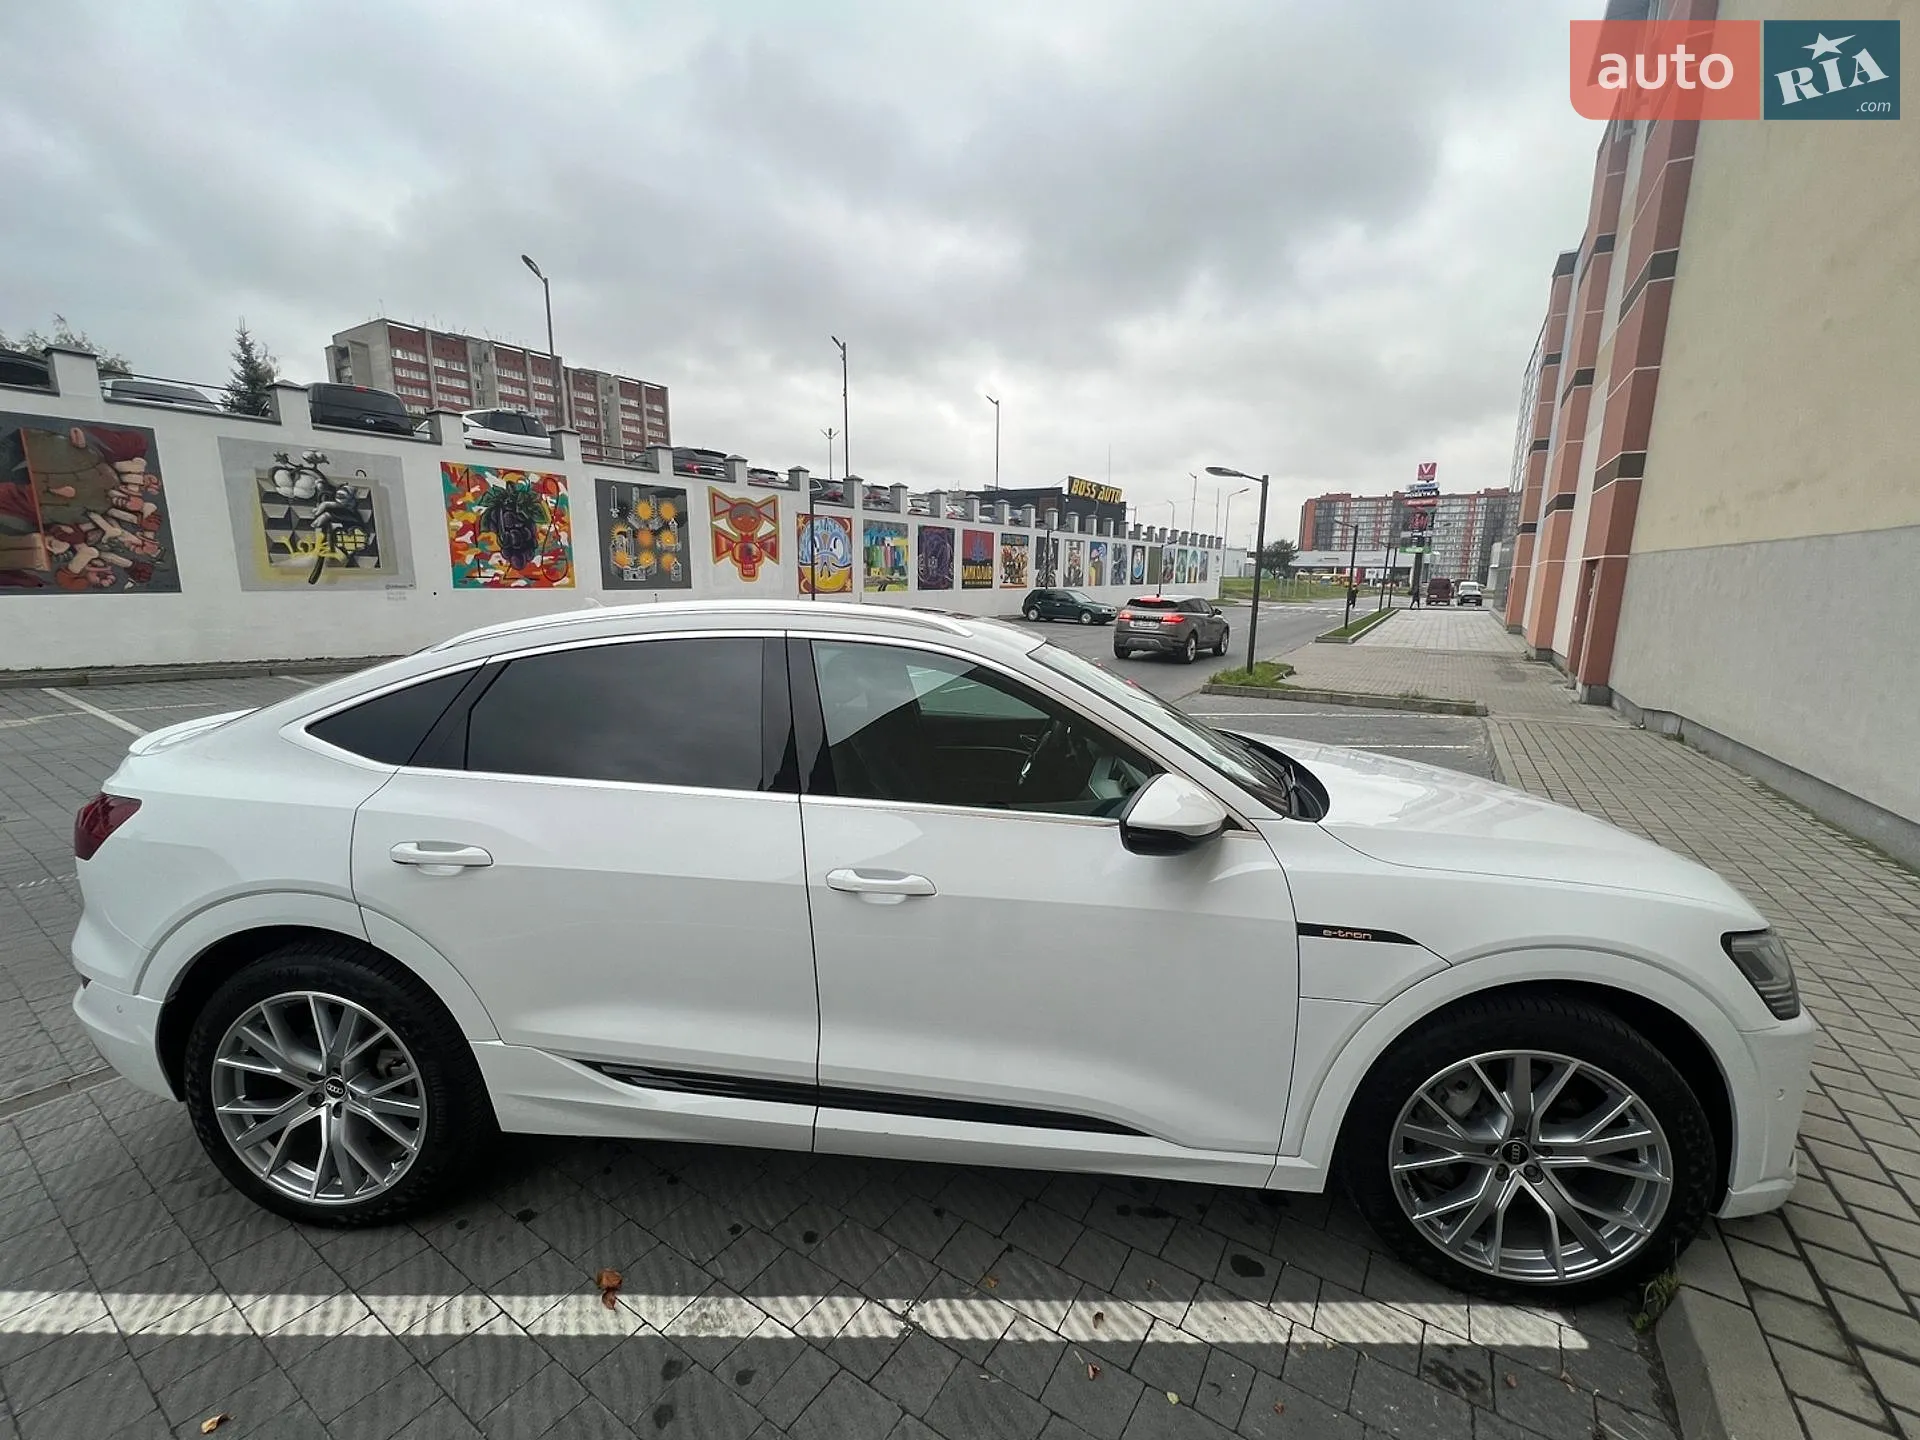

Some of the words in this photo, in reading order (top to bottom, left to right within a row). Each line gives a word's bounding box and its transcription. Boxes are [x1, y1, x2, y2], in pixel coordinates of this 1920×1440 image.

[1071, 479, 1096, 499] BOSS
[1098, 486, 1122, 504] AUTO
[1322, 929, 1372, 940] e-tron
